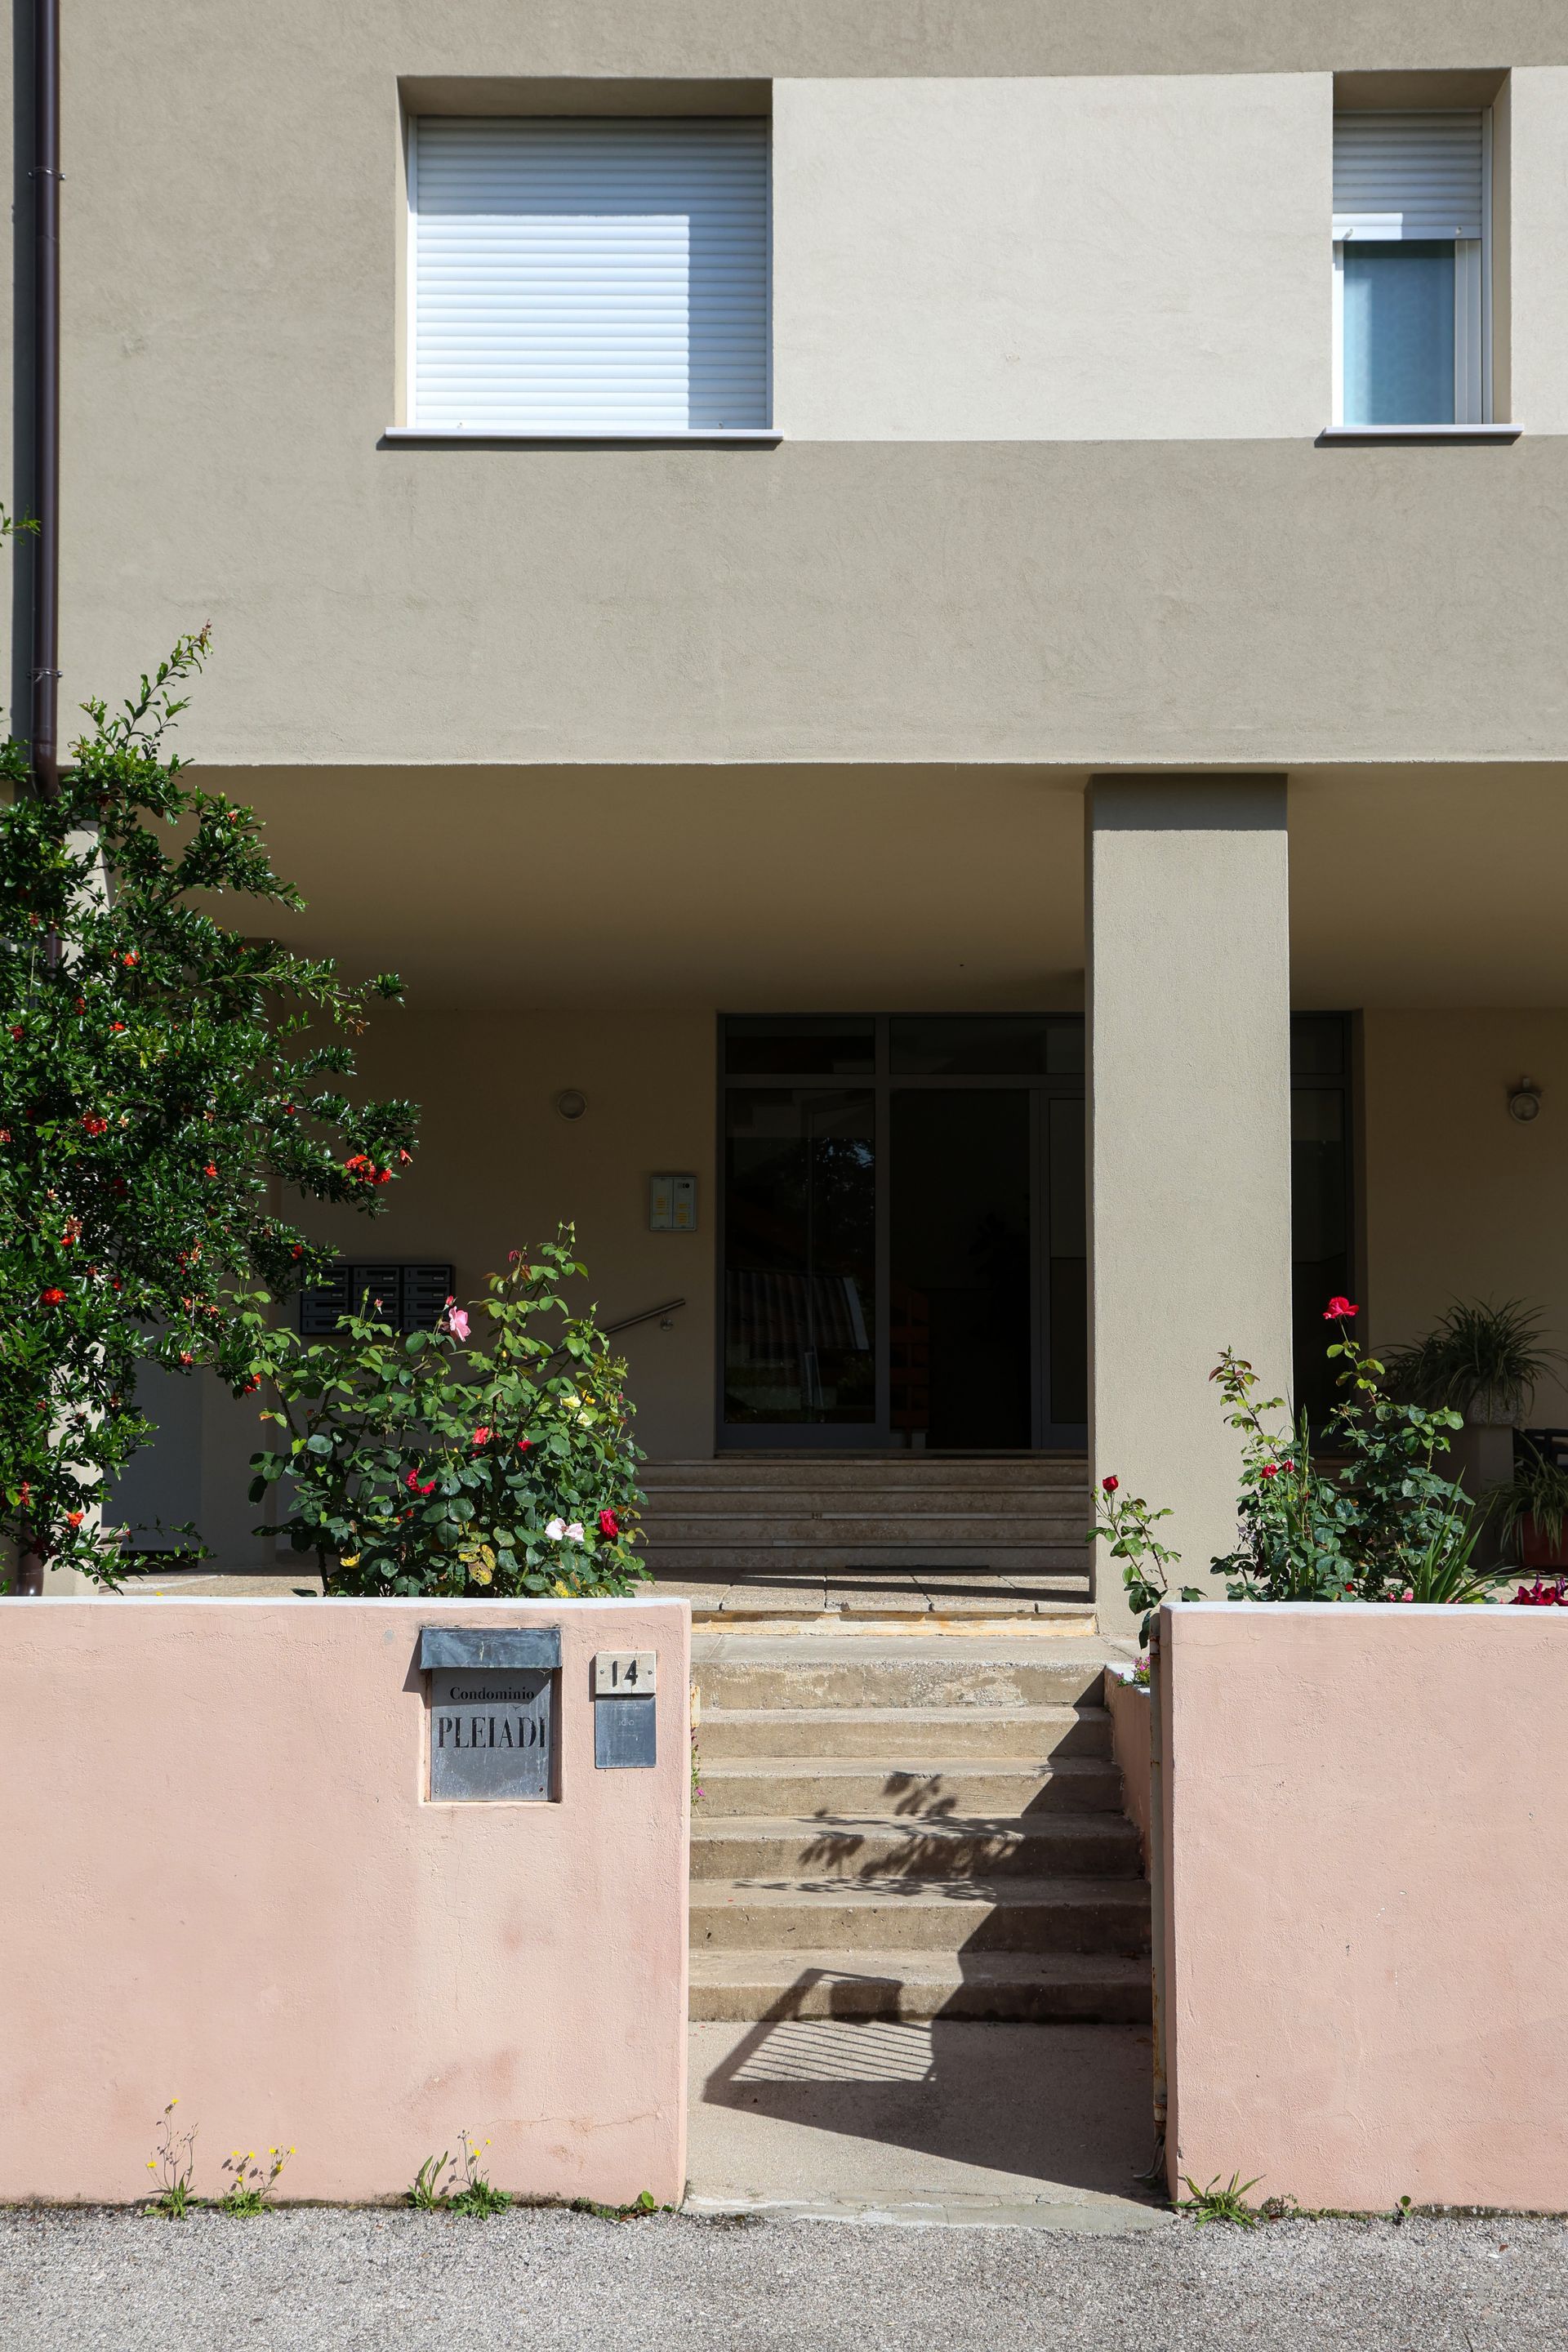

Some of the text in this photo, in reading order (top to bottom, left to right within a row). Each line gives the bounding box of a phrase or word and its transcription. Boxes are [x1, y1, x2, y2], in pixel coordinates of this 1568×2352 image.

[612, 1659, 639, 1687] 14
[449, 1686, 535, 1700] Condominio
[437, 1717, 547, 1748] PLEIADI
